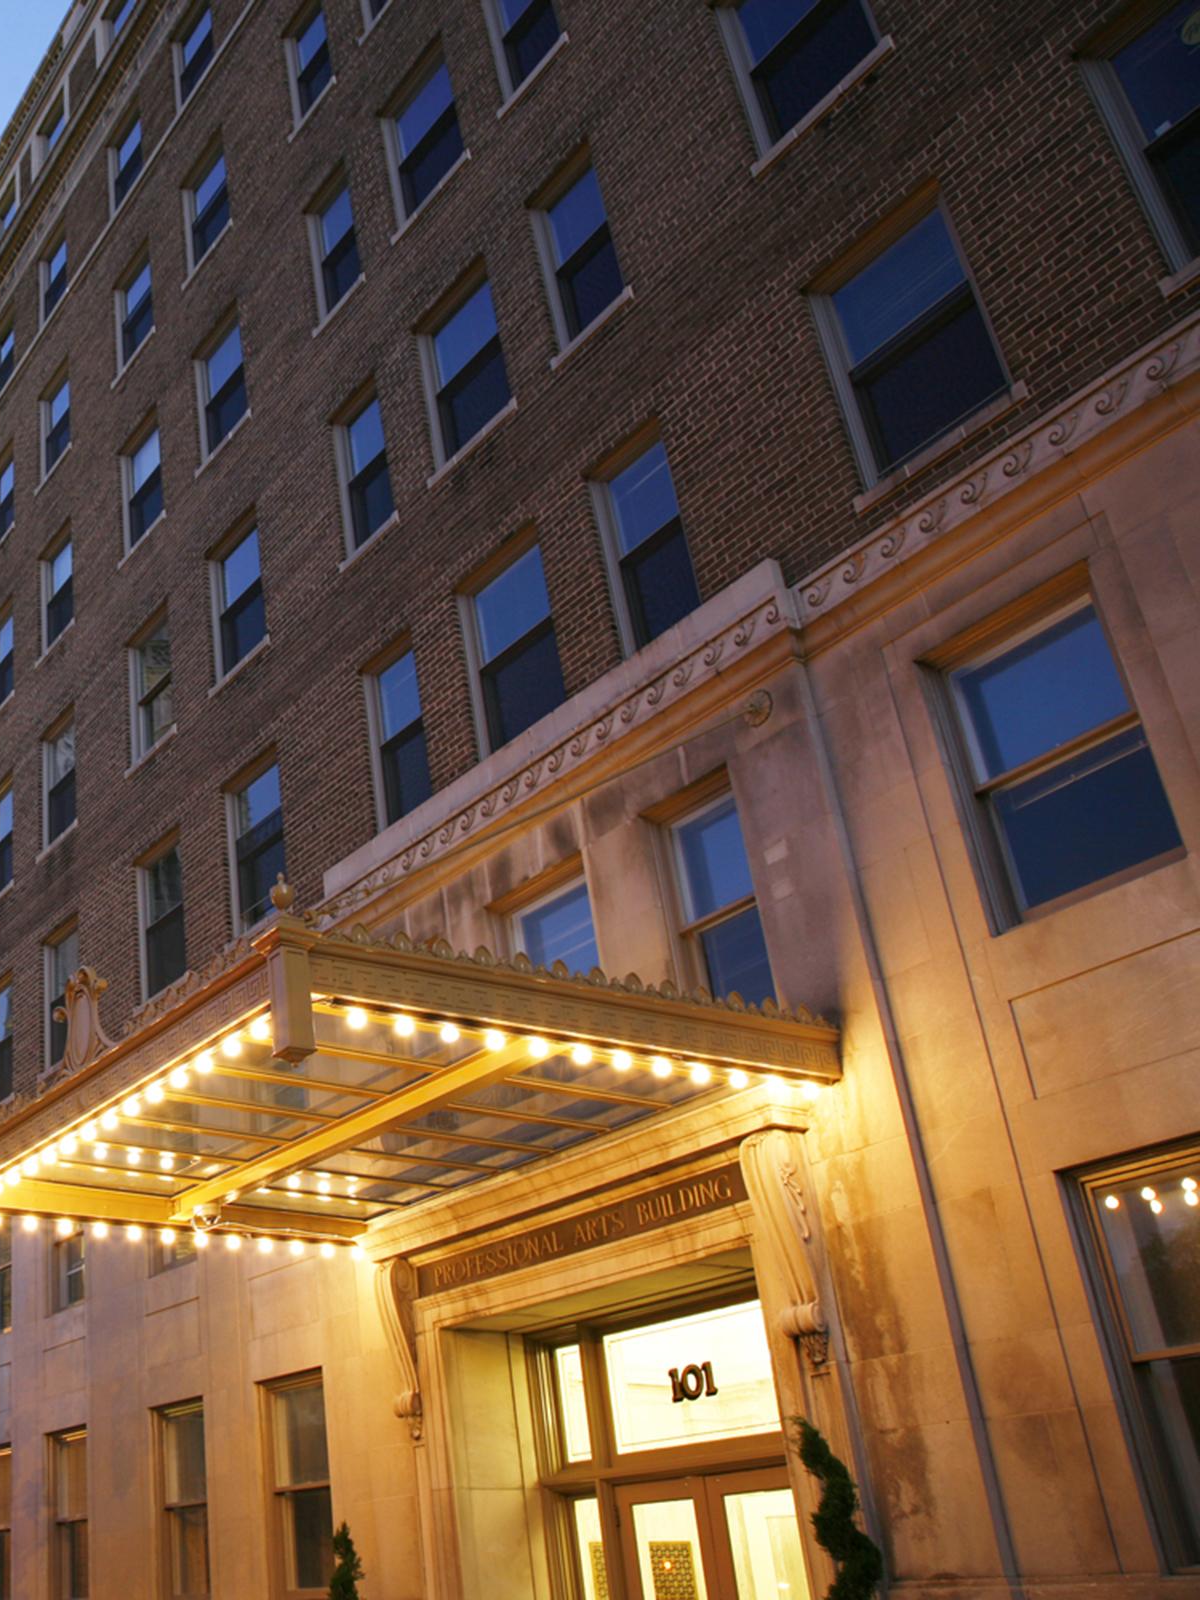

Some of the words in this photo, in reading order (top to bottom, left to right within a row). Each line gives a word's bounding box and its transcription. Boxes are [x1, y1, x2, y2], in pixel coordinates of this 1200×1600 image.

[433, 1236, 564, 1288] PROFESSIONAL
[573, 1212, 626, 1247] ARTS
[636, 1174, 732, 1227] BUILDING
[668, 1361, 718, 1403] 101
